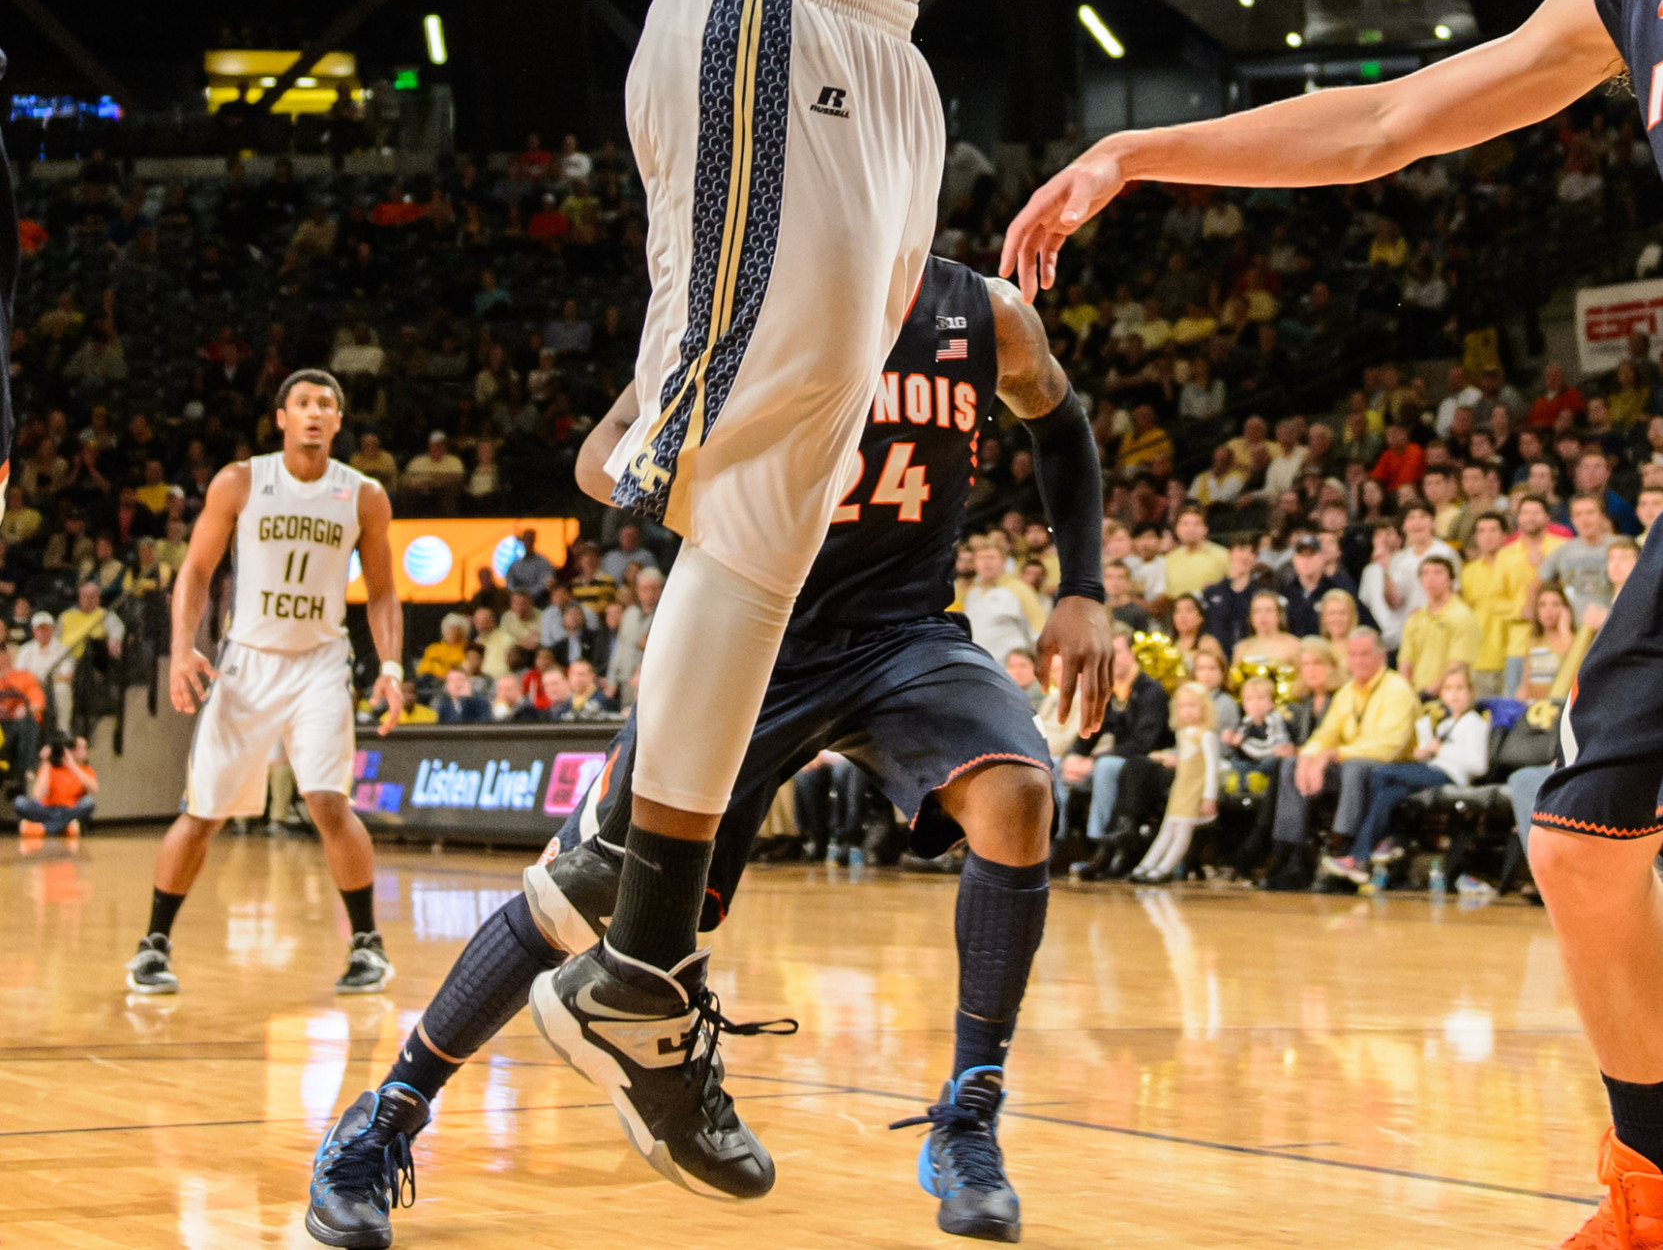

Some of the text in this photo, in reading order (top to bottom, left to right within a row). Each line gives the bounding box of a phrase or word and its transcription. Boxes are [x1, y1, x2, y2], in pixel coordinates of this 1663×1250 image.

[809, 103, 850, 119] RUSSELL
[258, 514, 344, 549] GEORGIA
[283, 550, 310, 584] 11
[260, 590, 325, 622] TECH
[411, 758, 481, 807] Listen
[477, 759, 544, 810] Live!
